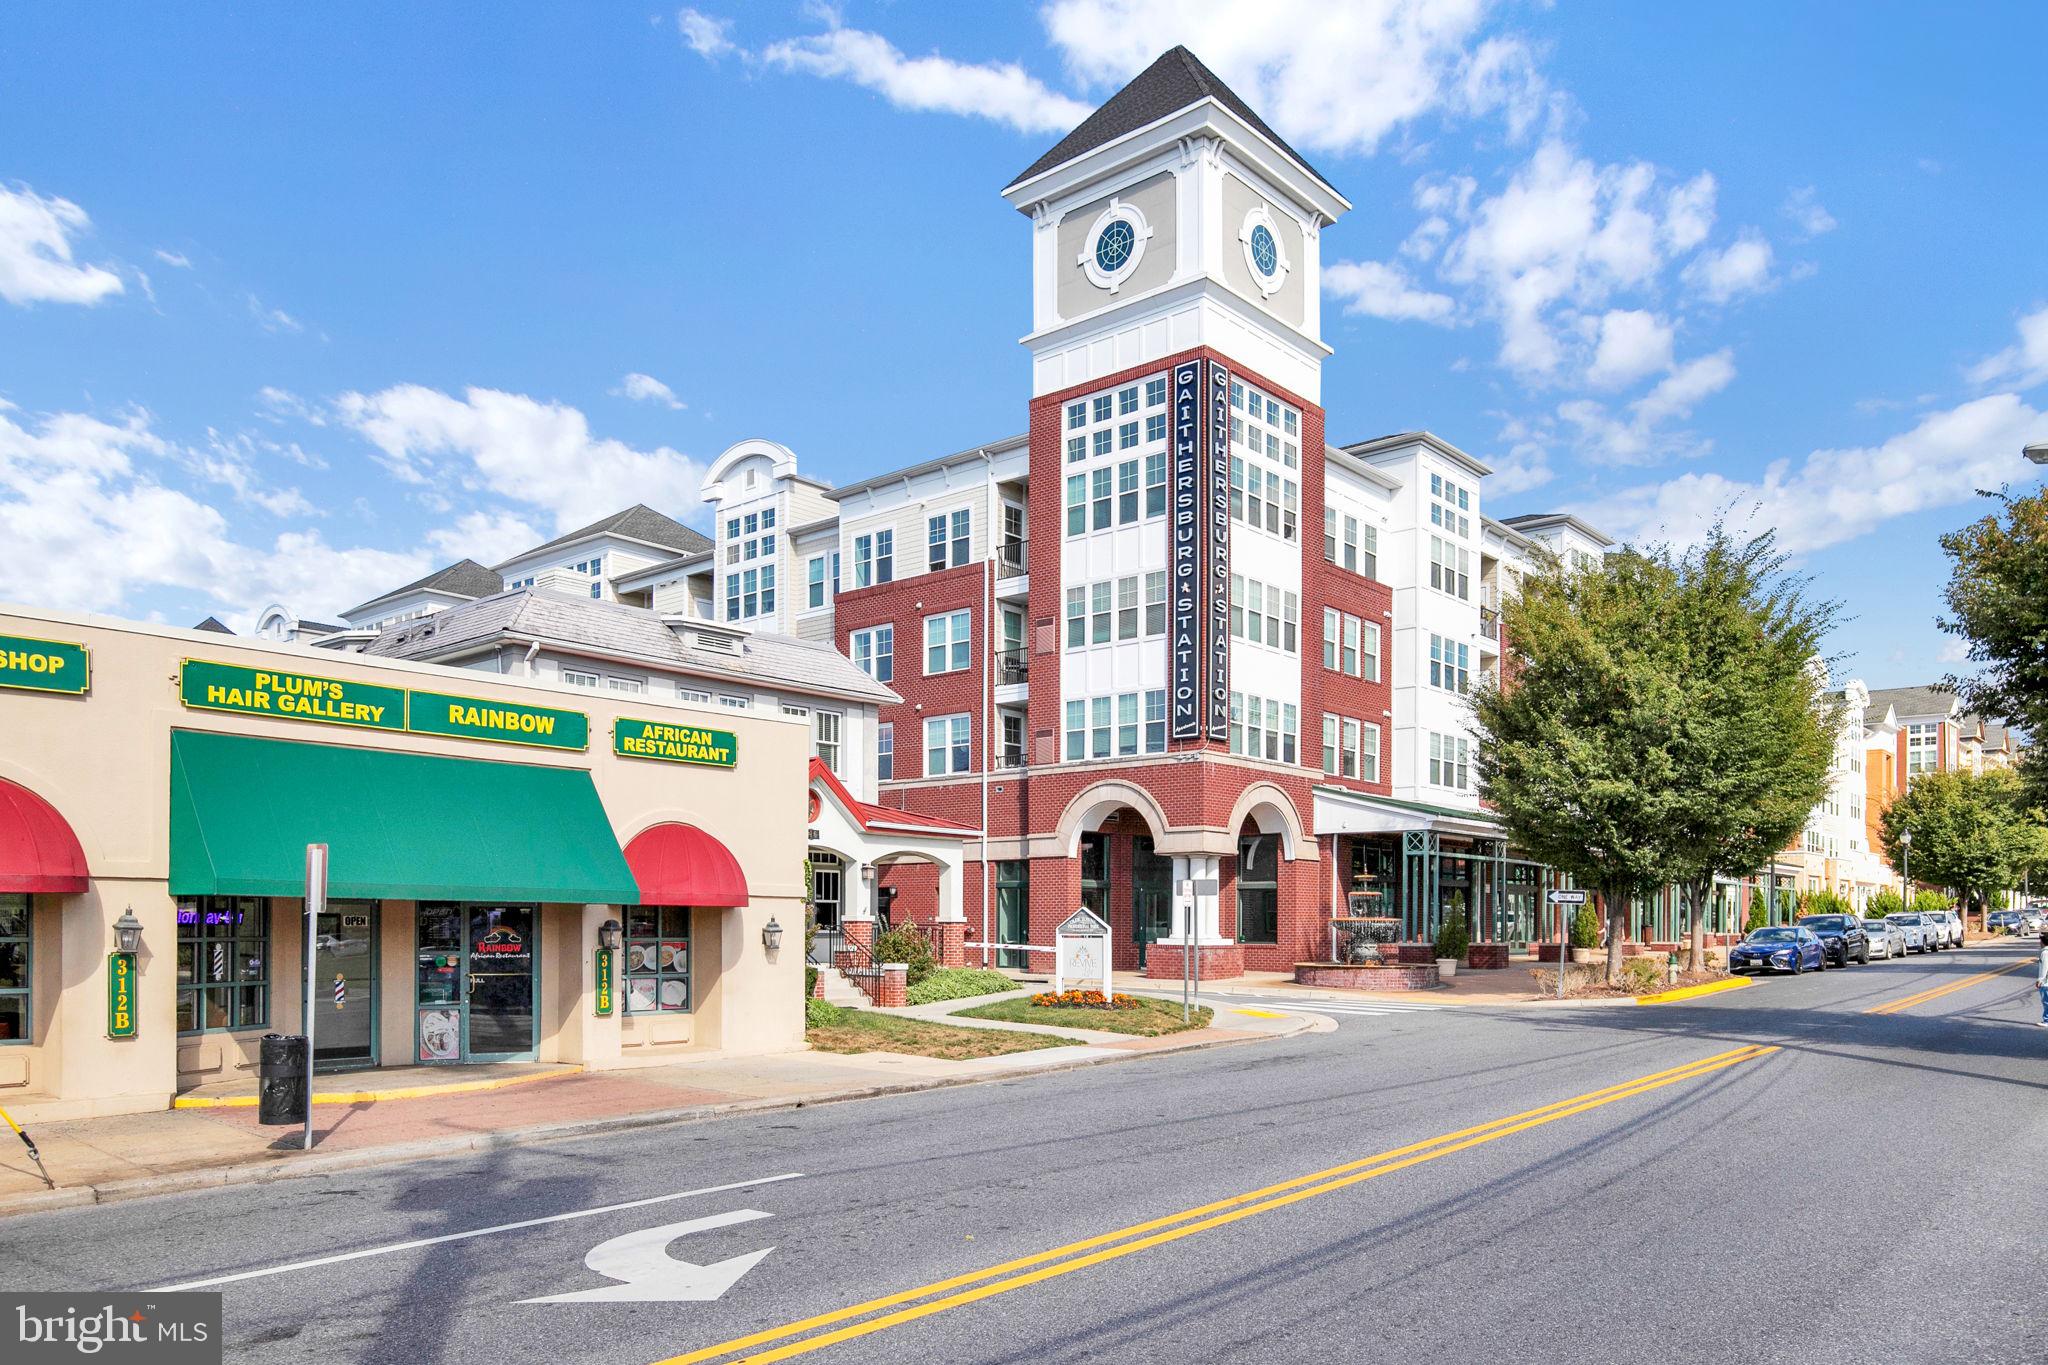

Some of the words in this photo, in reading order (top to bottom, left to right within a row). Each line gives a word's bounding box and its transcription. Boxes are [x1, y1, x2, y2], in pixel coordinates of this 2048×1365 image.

[1178, 370, 1194, 577] GAITHERSBURG
[1214, 372, 1227, 578] GAITHERSBURG
[1177, 598, 1193, 716] STATION
[1214, 600, 1227, 717] STATION
[207, 685, 271, 710] HAIR
[278, 694, 385, 722] GALLERY
[255, 673, 344, 700] PLUM'S
[449, 704, 555, 735] RAINBOW
[642, 724, 712, 746] AFRICAN
[623, 736, 730, 762] RESTAURANT
[345, 916, 367, 926] OPEN
[470, 952, 495, 961] African
[478, 941, 522, 953] RAINBOW
[115, 959, 130, 1029] 312B
[600, 954, 609, 1009] 312B
